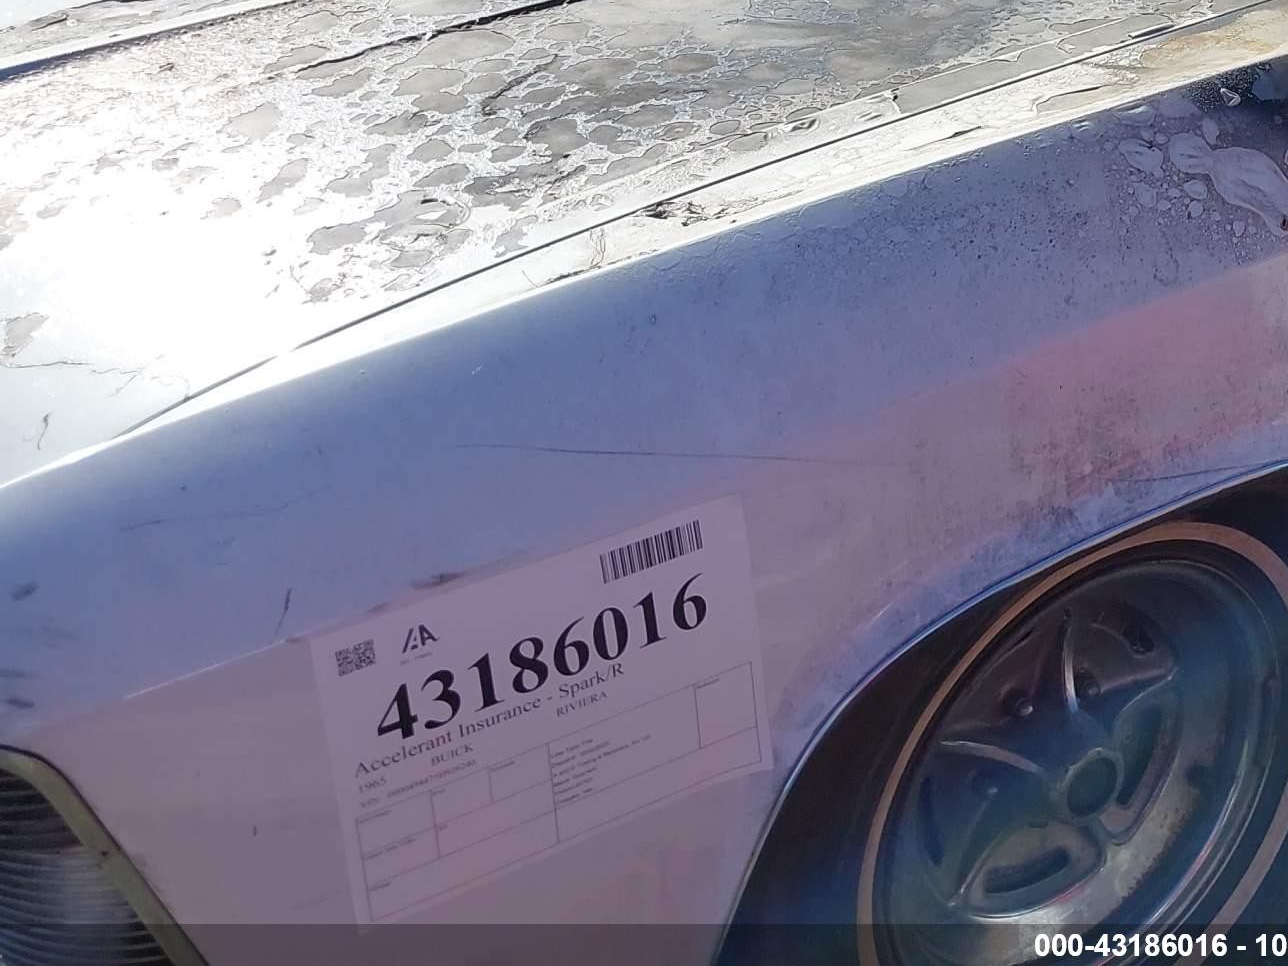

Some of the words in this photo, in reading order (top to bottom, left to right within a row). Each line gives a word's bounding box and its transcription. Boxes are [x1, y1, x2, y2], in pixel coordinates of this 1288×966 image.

[376, 572, 707, 740] 43186016
[355, 731, 452, 779] Accelerant
[458, 696, 541, 739] Insurance
[558, 663, 624, 699] Spark/R
[431, 742, 474, 767] BUICK
[556, 691, 608, 717] RIVIERA
